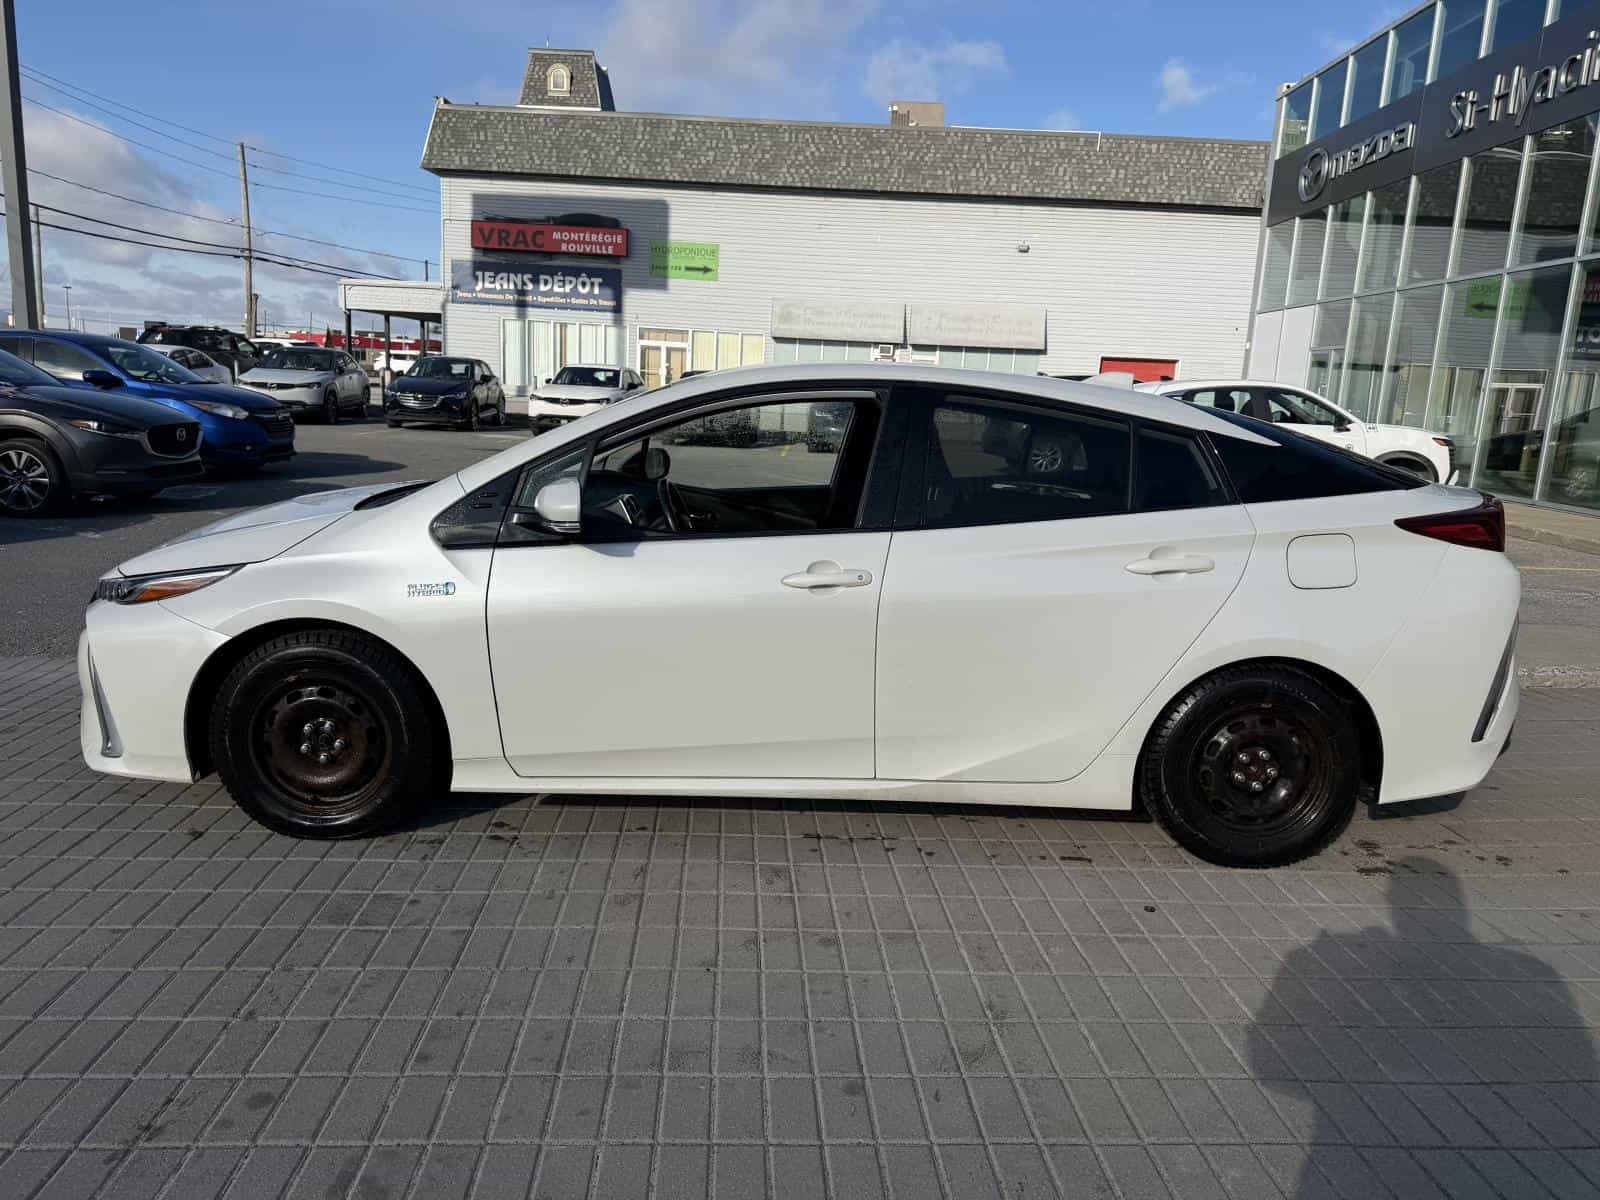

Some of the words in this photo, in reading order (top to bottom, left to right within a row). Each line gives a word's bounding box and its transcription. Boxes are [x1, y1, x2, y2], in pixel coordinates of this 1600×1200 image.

[1327, 121, 1416, 179] mazda
[478, 227, 545, 248] VRAC
[560, 242, 614, 255] ROUVILLE
[474, 271, 534, 291] JEANS
[538, 272, 603, 295] DÉPÔT
